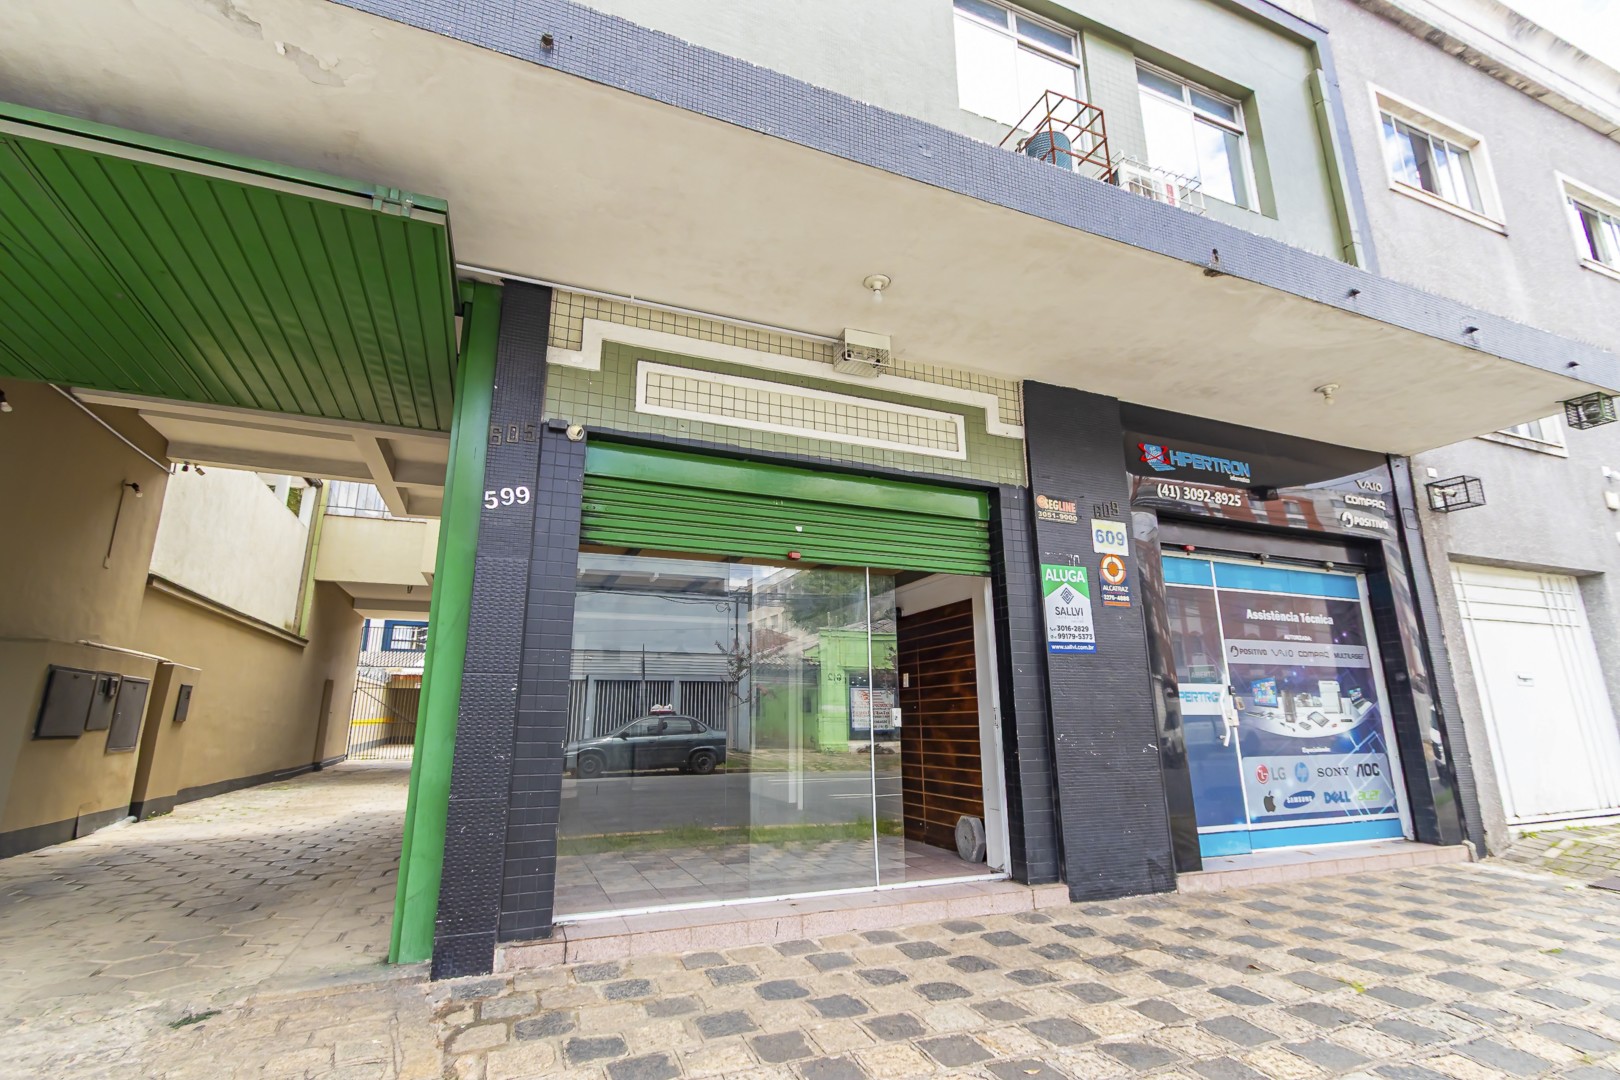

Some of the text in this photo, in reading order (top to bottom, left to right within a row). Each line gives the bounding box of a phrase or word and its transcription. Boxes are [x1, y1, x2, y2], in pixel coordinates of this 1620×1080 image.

[1355, 479, 1383, 492] VAIO
[484, 486, 530, 509] 599
[1157, 483, 1242, 507] (41) 3092-8925
[1044, 498, 1077, 513] SEGLINE
[1344, 494, 1387, 511] COMPAQ
[1038, 510, 1078, 522] 3051-9000
[1353, 516, 1390, 530] POSITIVO
[1095, 528, 1126, 547] 609
[1045, 568, 1086, 583] ALUGA
[1102, 584, 1129, 593] ALCATRAZ
[1054, 606, 1084, 617] SALLVI
[1246, 608, 1334, 625] Assistência Técnica
[1051, 643, 1095, 651] www.sallvi.com.br
[1239, 648, 1268, 656] POSITIVO
[1271, 648, 1294, 657] VAIO
[1271, 767, 1287, 781] LG
[1317, 766, 1350, 778] SONY
[1356, 762, 1381, 778] AOC
[1286, 795, 1313, 804] SAMSUNG
[1323, 790, 1351, 804] DELL
[1357, 789, 1382, 801] acer
